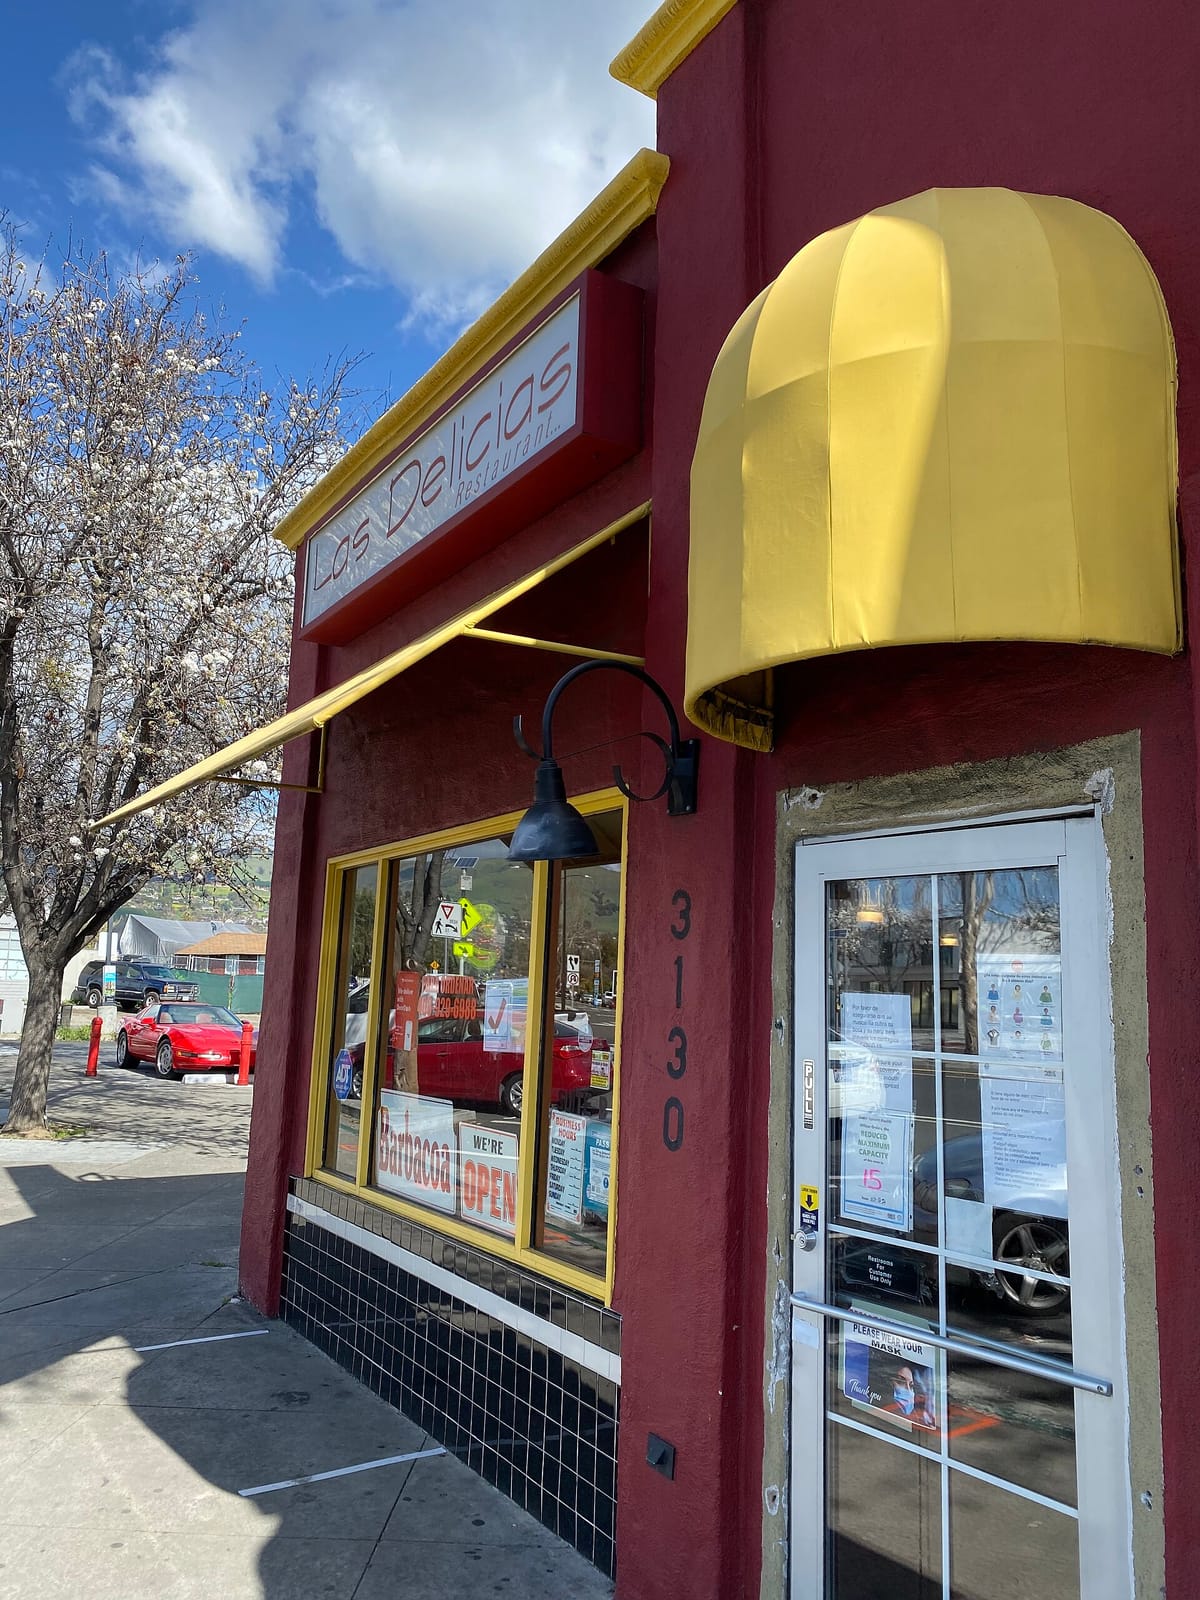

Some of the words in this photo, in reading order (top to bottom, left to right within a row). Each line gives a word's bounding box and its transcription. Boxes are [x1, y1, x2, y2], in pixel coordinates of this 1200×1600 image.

[313, 517, 370, 590] Las
[386, 342, 572, 538] Delicias
[335, 1064, 351, 1084] ADT
[805, 1065, 813, 1113] PULL
[555, 1117, 581, 1132] BUSINESS
[558, 1127, 577, 1141] HOURS
[858, 1139, 890, 1151] MAXIMUM
[860, 1130, 888, 1141] REDUCED
[379, 1106, 451, 1193] Barbacoa
[473, 1135, 504, 1156] WE'RE
[858, 1148, 889, 1160] CAPACITY
[863, 1168, 882, 1190] 15
[463, 1160, 517, 1225] OPEN
[867, 1255, 893, 1266] Restrooms
[869, 1268, 892, 1279] Customer
[869, 1274, 879, 1282] Use
[880, 1277, 892, 1286] Only
[852, 1323, 881, 1342] PLEASE
[881, 1331, 901, 1347] WEAR
[902, 1340, 923, 1356] YOUR
[871, 1339, 903, 1357] MASK
[849, 1378, 870, 1399] Thank
[869, 1390, 882, 1404] you
